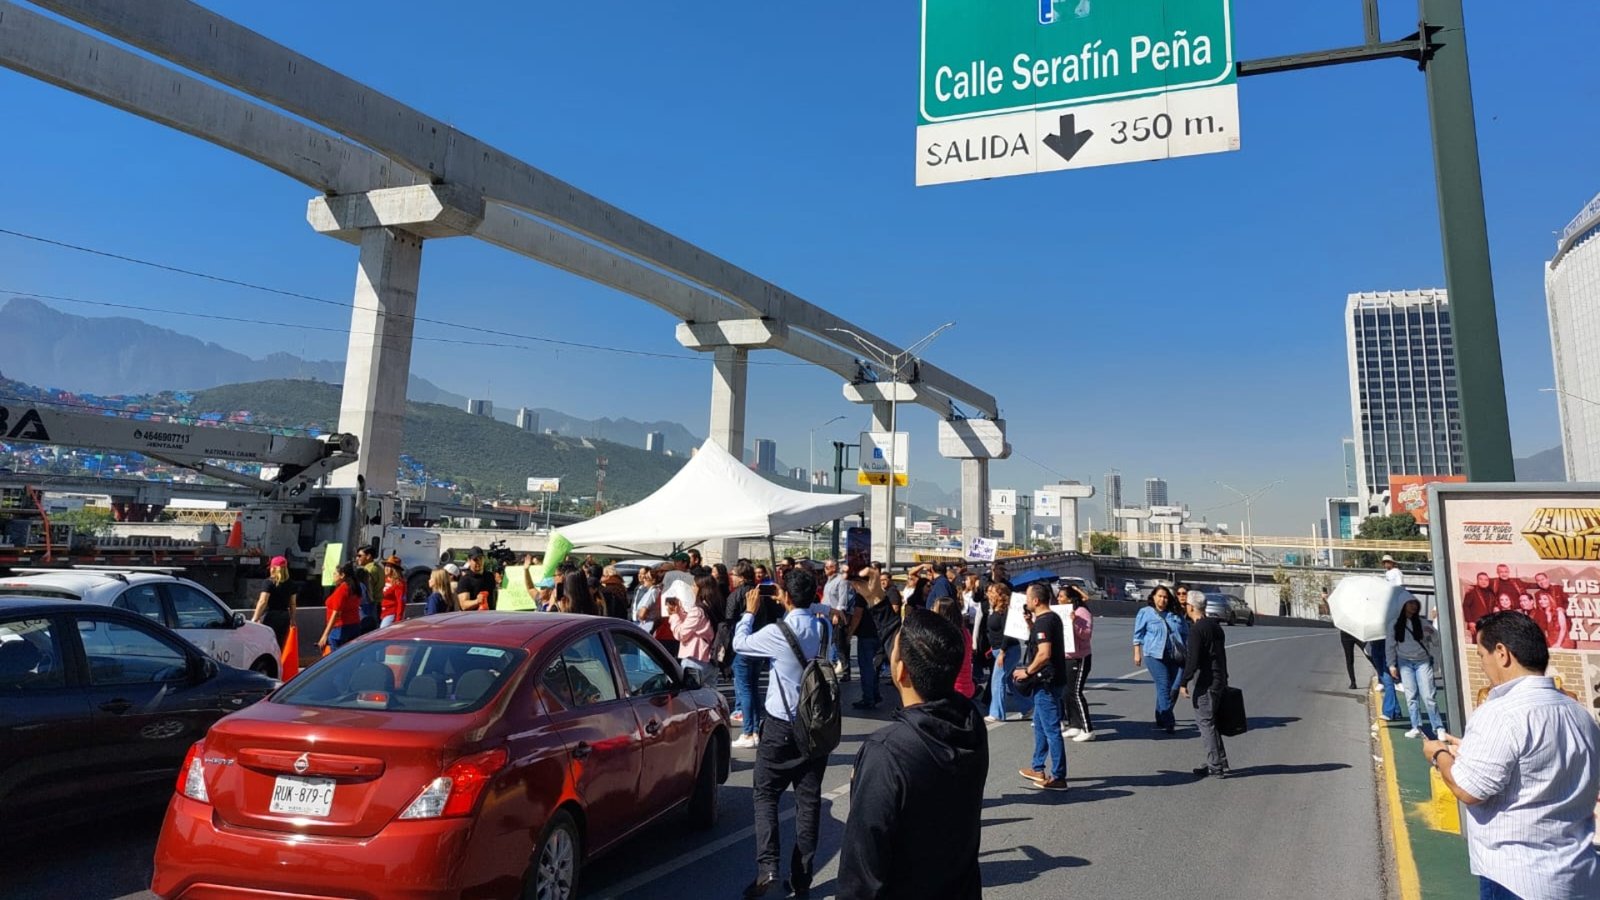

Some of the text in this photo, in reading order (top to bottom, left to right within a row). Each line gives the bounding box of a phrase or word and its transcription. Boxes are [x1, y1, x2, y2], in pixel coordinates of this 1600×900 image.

[934, 29, 1212, 102] Calle Serafín Peña
[926, 113, 1225, 167] SALIDA 350 m.
[1521, 533, 1600, 560] RODE
[1562, 579, 1600, 594] LOS
[273, 785, 332, 804] RUK-879-C
